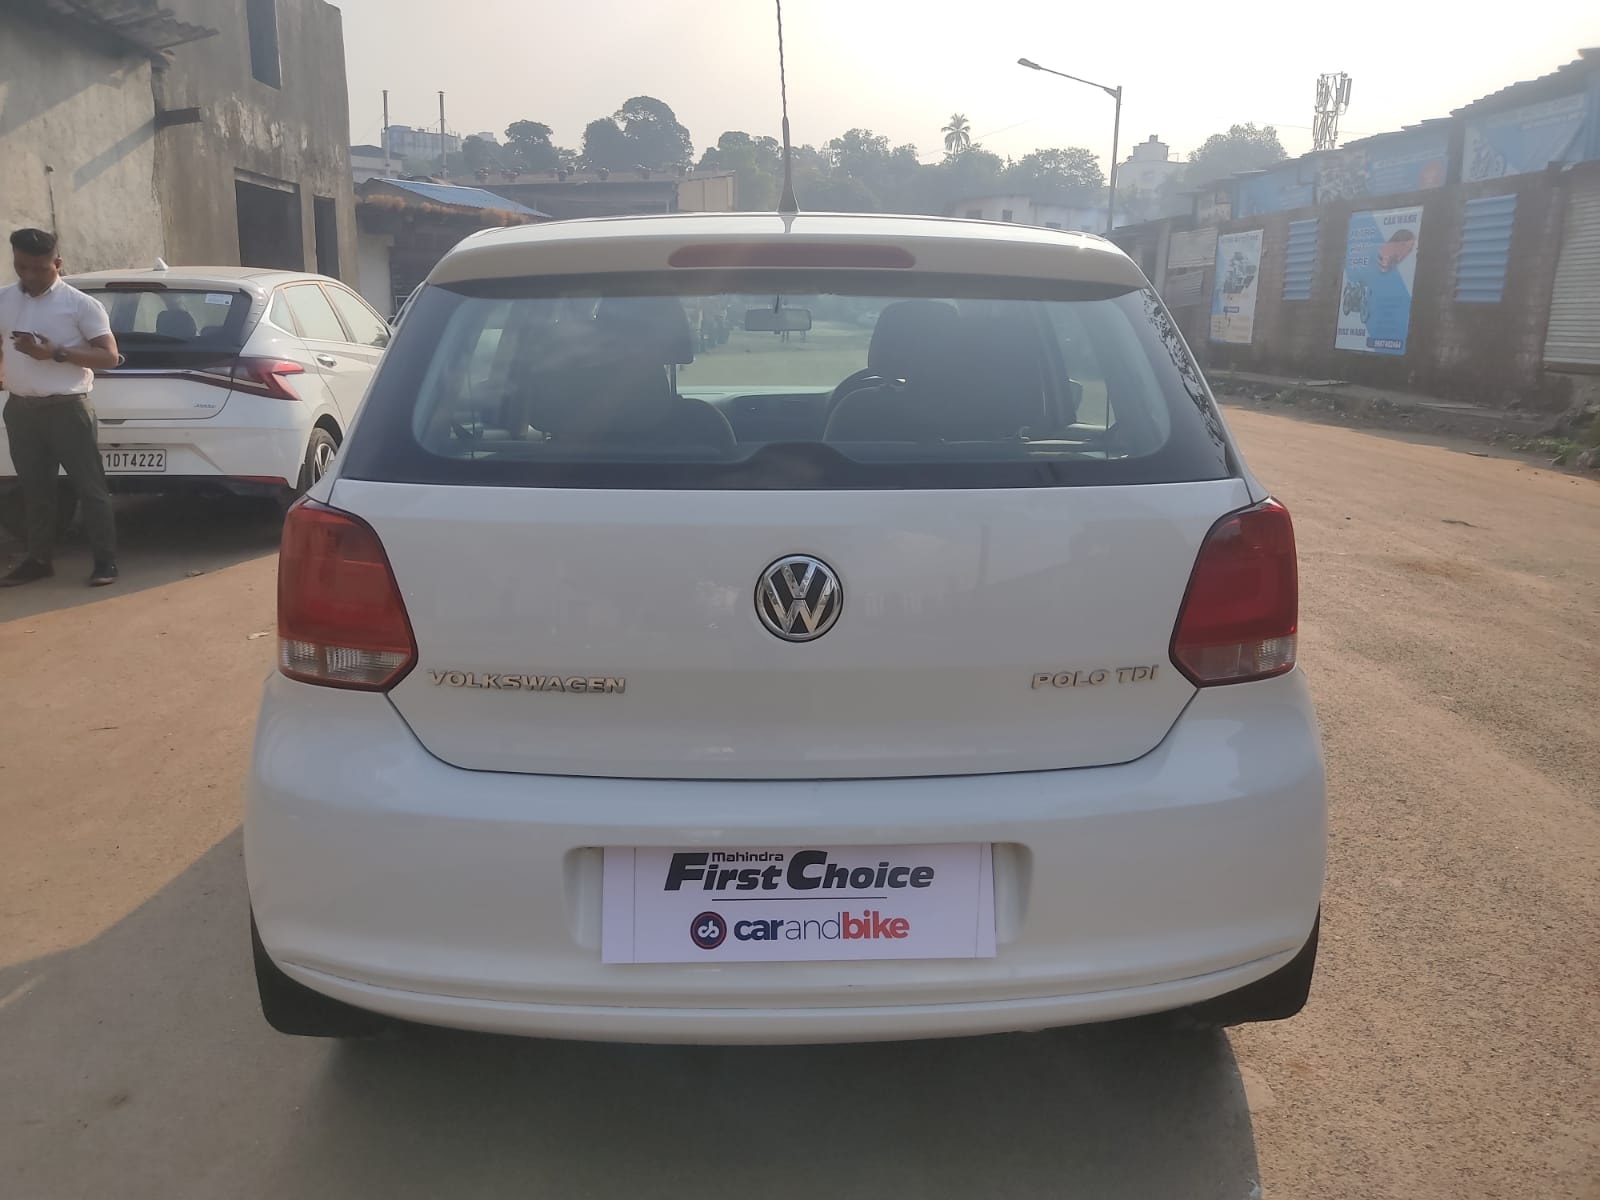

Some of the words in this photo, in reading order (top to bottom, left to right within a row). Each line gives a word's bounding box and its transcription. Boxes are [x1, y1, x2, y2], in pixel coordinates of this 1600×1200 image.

[429, 670, 626, 694] VOLKSWAGEN
[1031, 669, 1109, 690] POLO
[1115, 664, 1160, 685] TDI
[711, 851, 784, 863] Mahindra
[664, 852, 785, 891] First
[786, 850, 934, 890] Choice
[733, 909, 910, 941] carandbike
